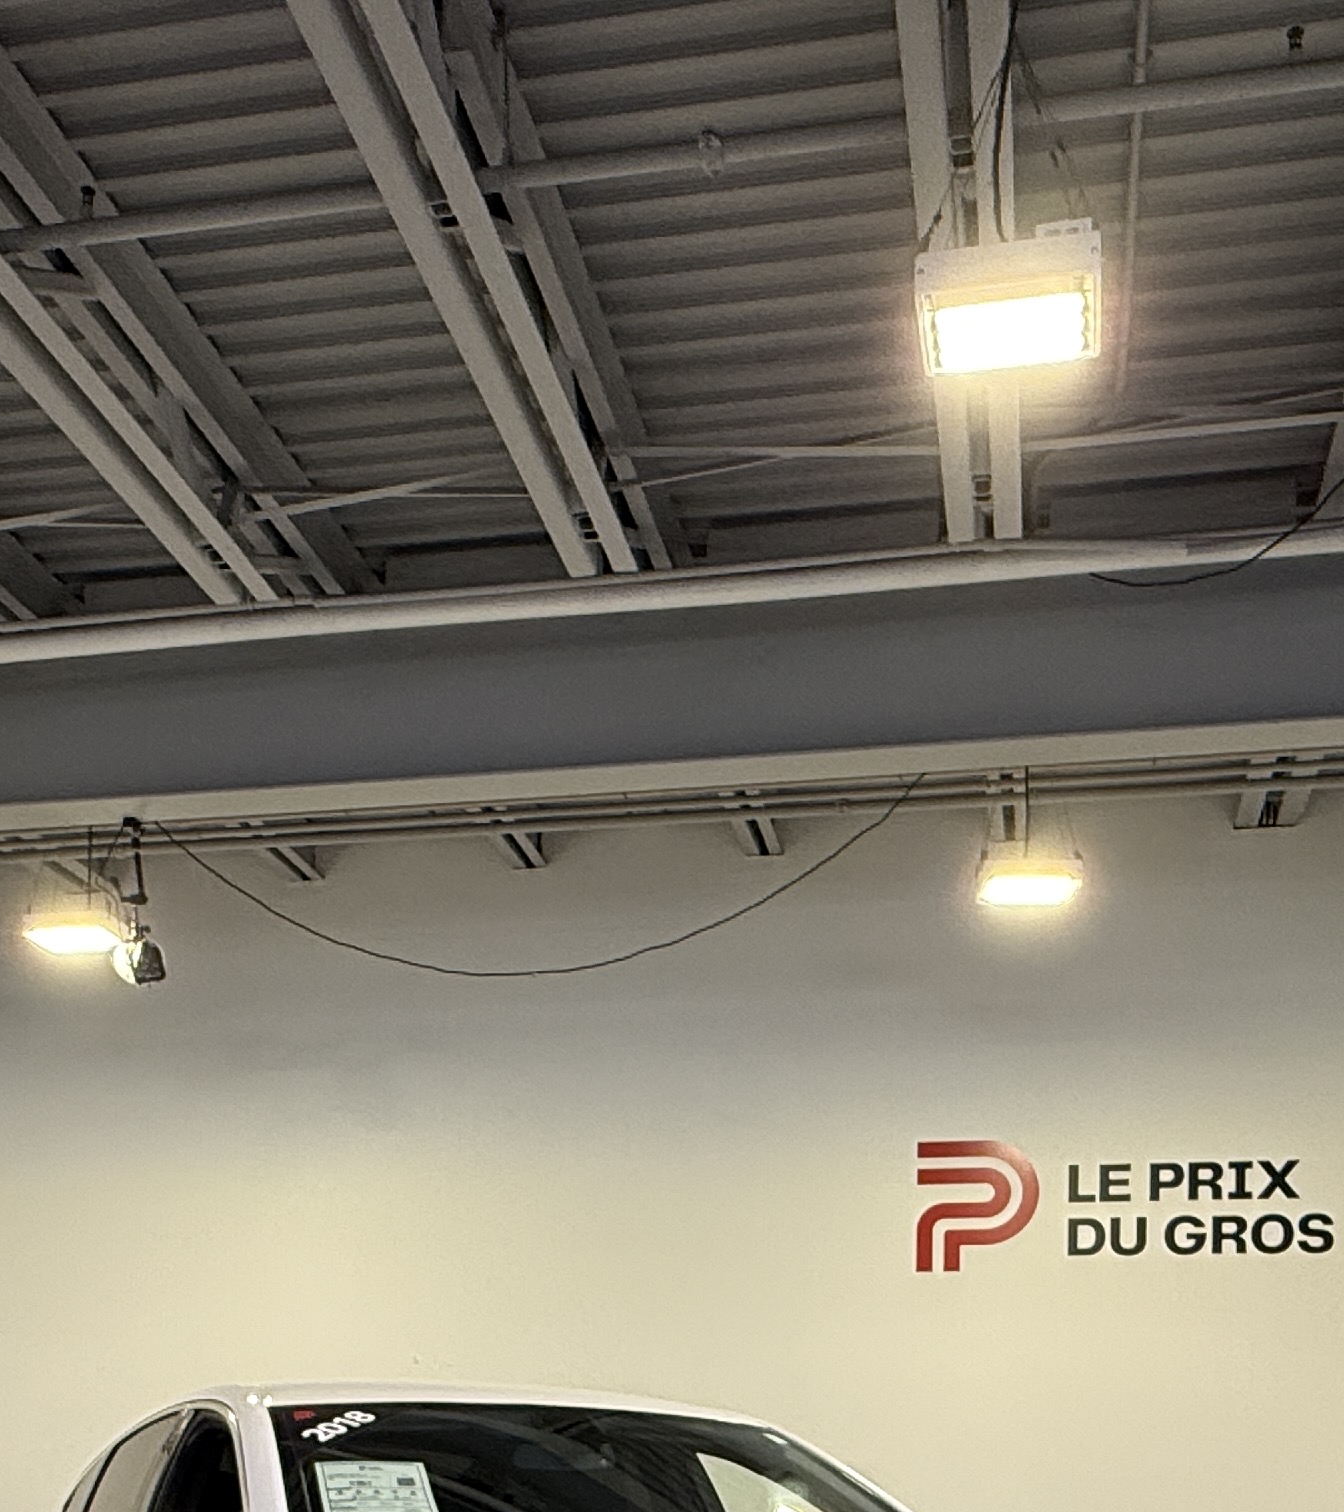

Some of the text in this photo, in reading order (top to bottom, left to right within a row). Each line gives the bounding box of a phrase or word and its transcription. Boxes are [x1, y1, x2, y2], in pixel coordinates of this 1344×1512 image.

[1068, 1159, 1300, 1203] LE PRIX
[1067, 1213, 1334, 1256] DU GROS
[301, 1410, 376, 1443] 2018
